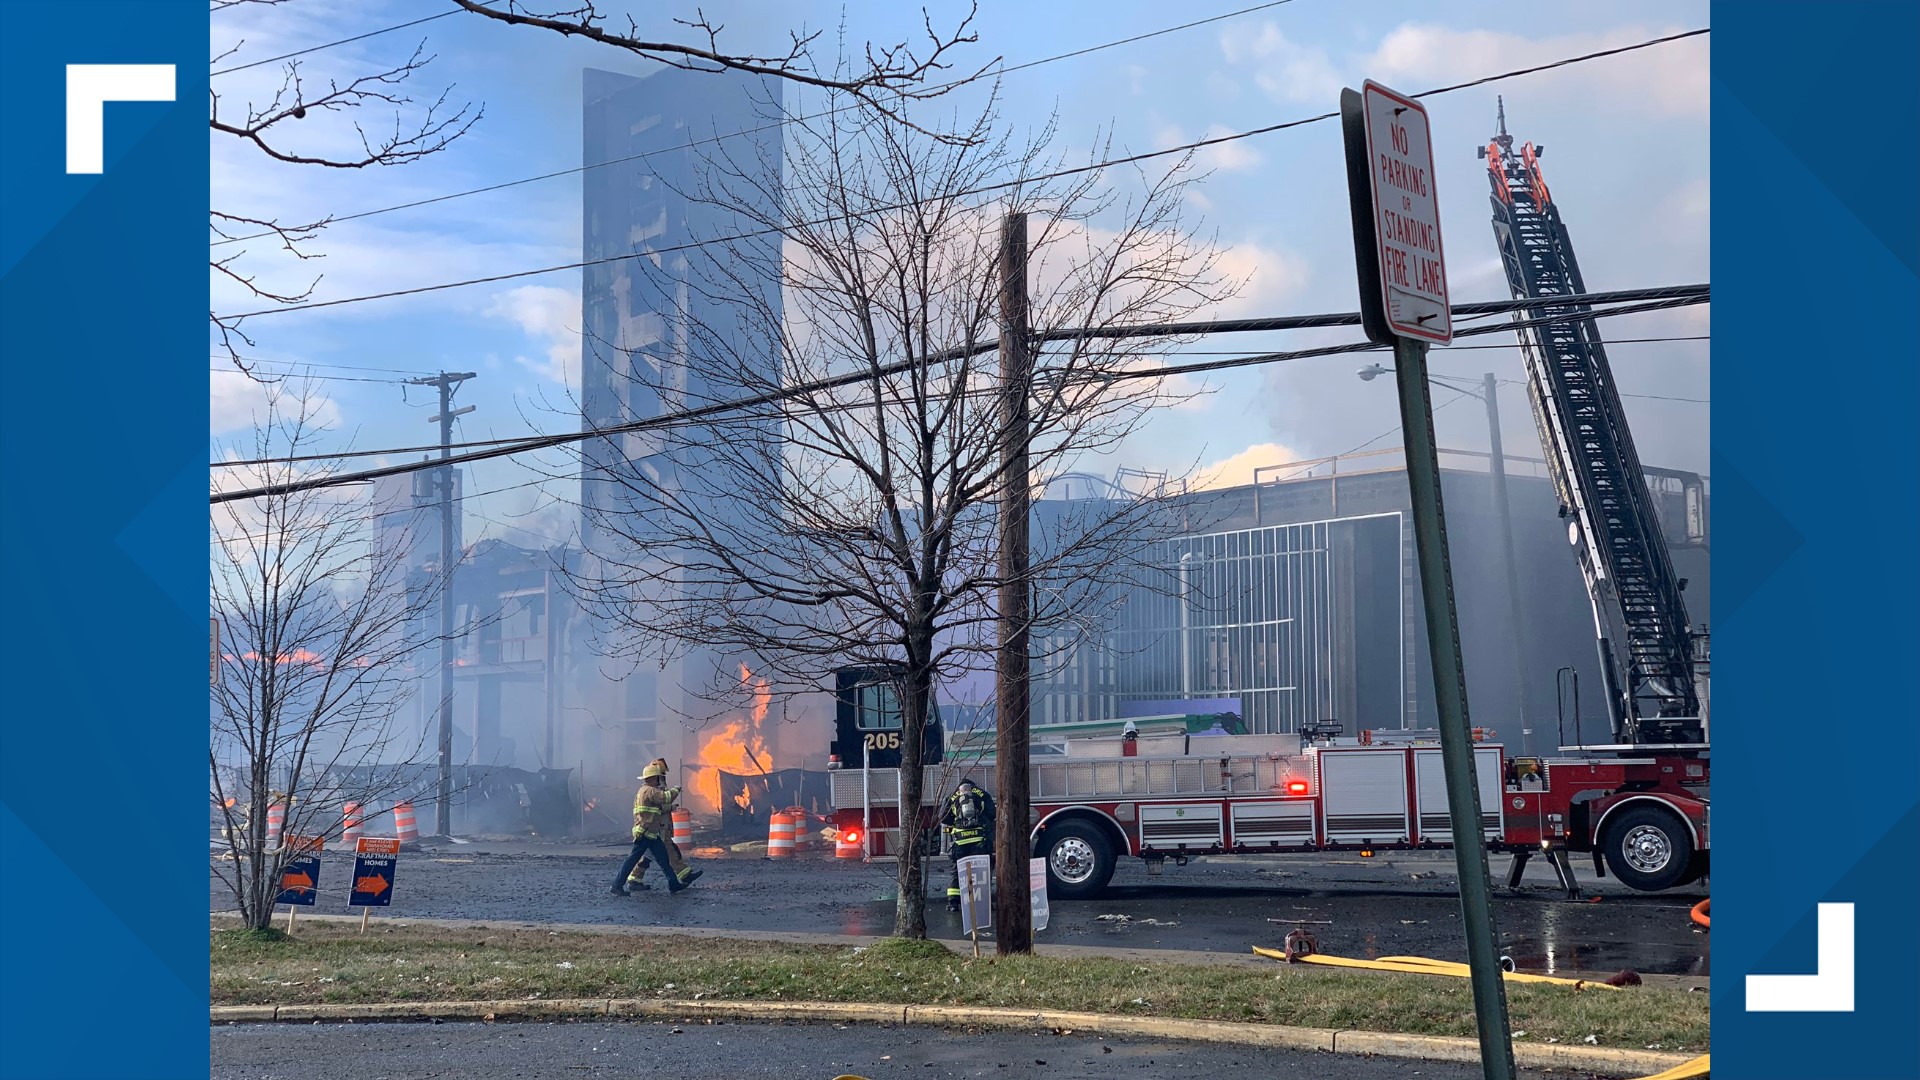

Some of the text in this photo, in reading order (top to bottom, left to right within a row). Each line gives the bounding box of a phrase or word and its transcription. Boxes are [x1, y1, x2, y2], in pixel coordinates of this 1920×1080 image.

[1391, 122, 1408, 156] NO
[1381, 153, 1427, 198] PARKING
[1402, 195, 1412, 212] OR
[1384, 209, 1435, 253] STANDING
[1385, 246, 1443, 297] FIRE LANE
[864, 733, 899, 749] 205
[357, 852, 396, 860] CRAFTMARK
